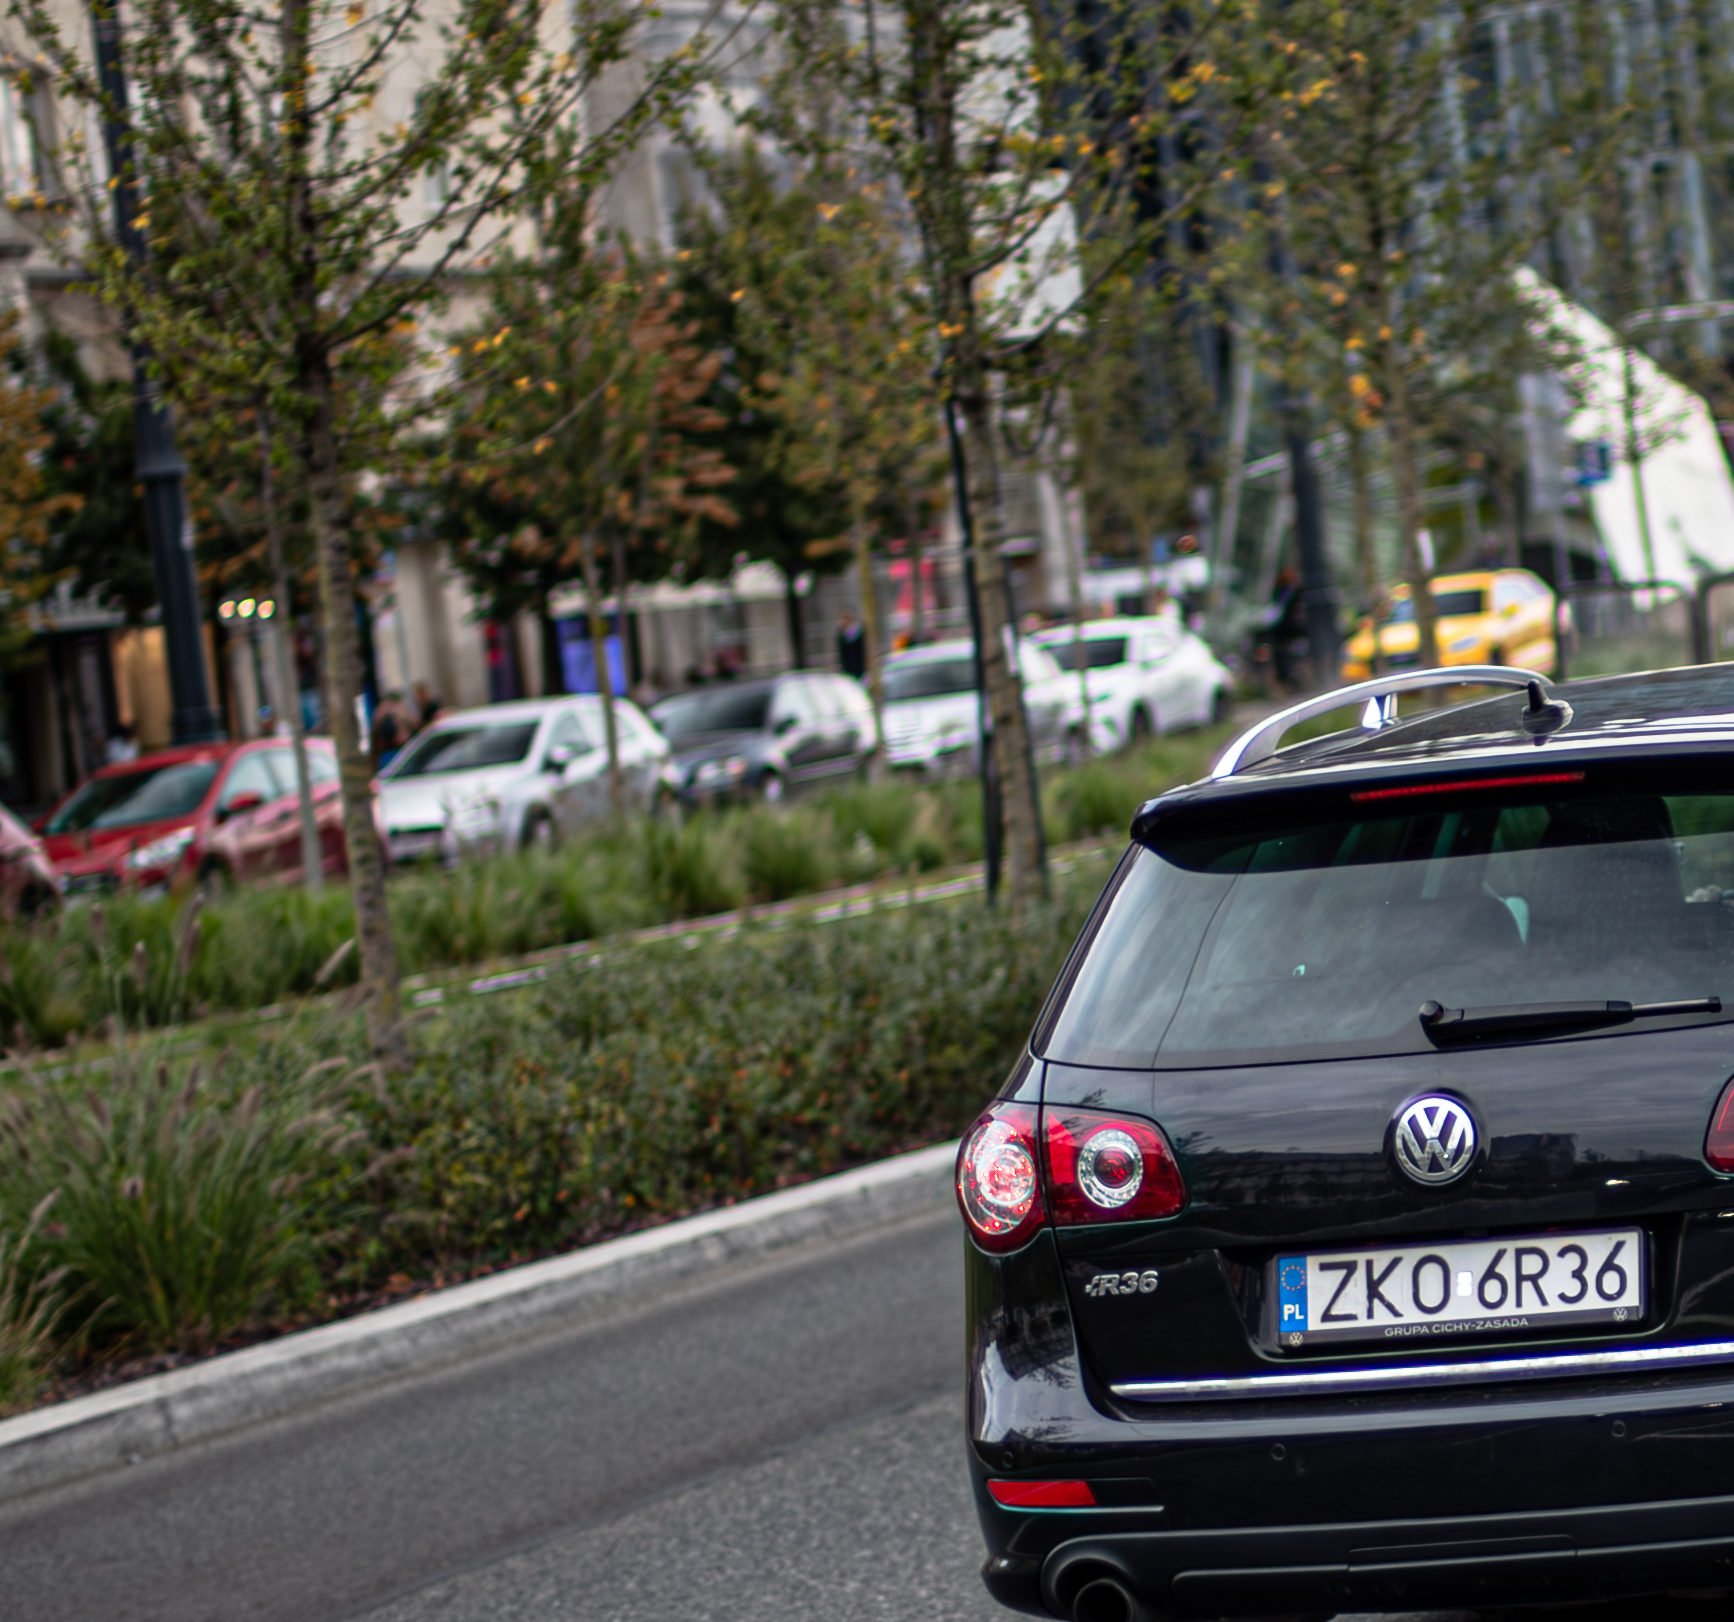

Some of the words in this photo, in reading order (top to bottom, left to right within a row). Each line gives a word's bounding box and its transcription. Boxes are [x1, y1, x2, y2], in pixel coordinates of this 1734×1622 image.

[1086, 1270, 1158, 1297] R36
[1319, 1254, 1451, 1323] ZKO
[1478, 1239, 1627, 1310] 6R36
[1284, 1303, 1304, 1321] PL
[1384, 1324, 1429, 1337] GRUPA
[1432, 1318, 1529, 1333] CICHY-ZASADA
